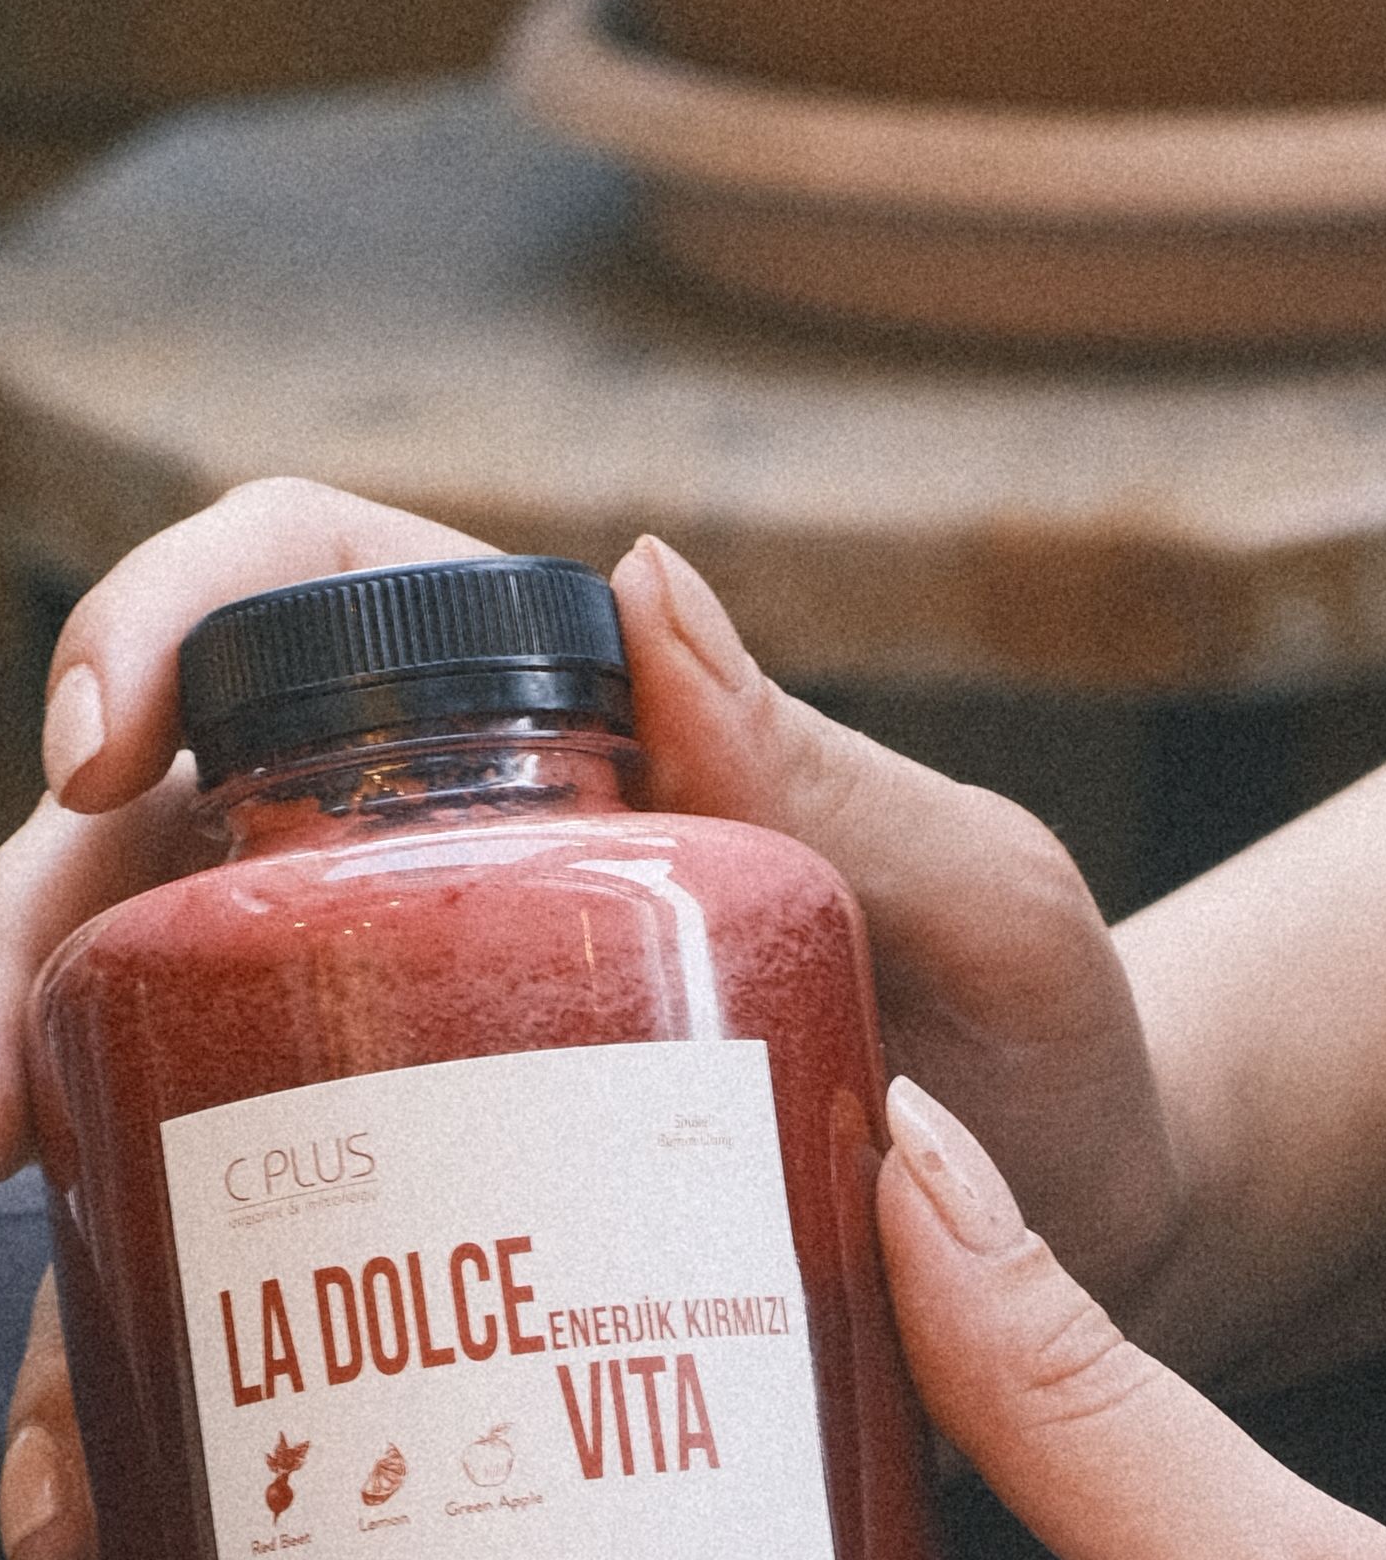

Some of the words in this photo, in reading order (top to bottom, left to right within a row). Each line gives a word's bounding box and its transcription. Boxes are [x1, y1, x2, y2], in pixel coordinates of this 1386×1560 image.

[264, 1131, 376, 1195] PLUS
[220, 1277, 305, 1407] LA
[313, 1235, 546, 1386] DOLCE
[548, 1295, 678, 1351] ENERJİK
[684, 1296, 790, 1339] KIRMIZI
[555, 1353, 721, 1480] VITA
[358, 1514, 412, 1532] Lemon
[444, 1501, 494, 1517] Green
[499, 1491, 544, 1513] Apple
[251, 1536, 277, 1556] Red
[279, 1533, 312, 1549] Beet
